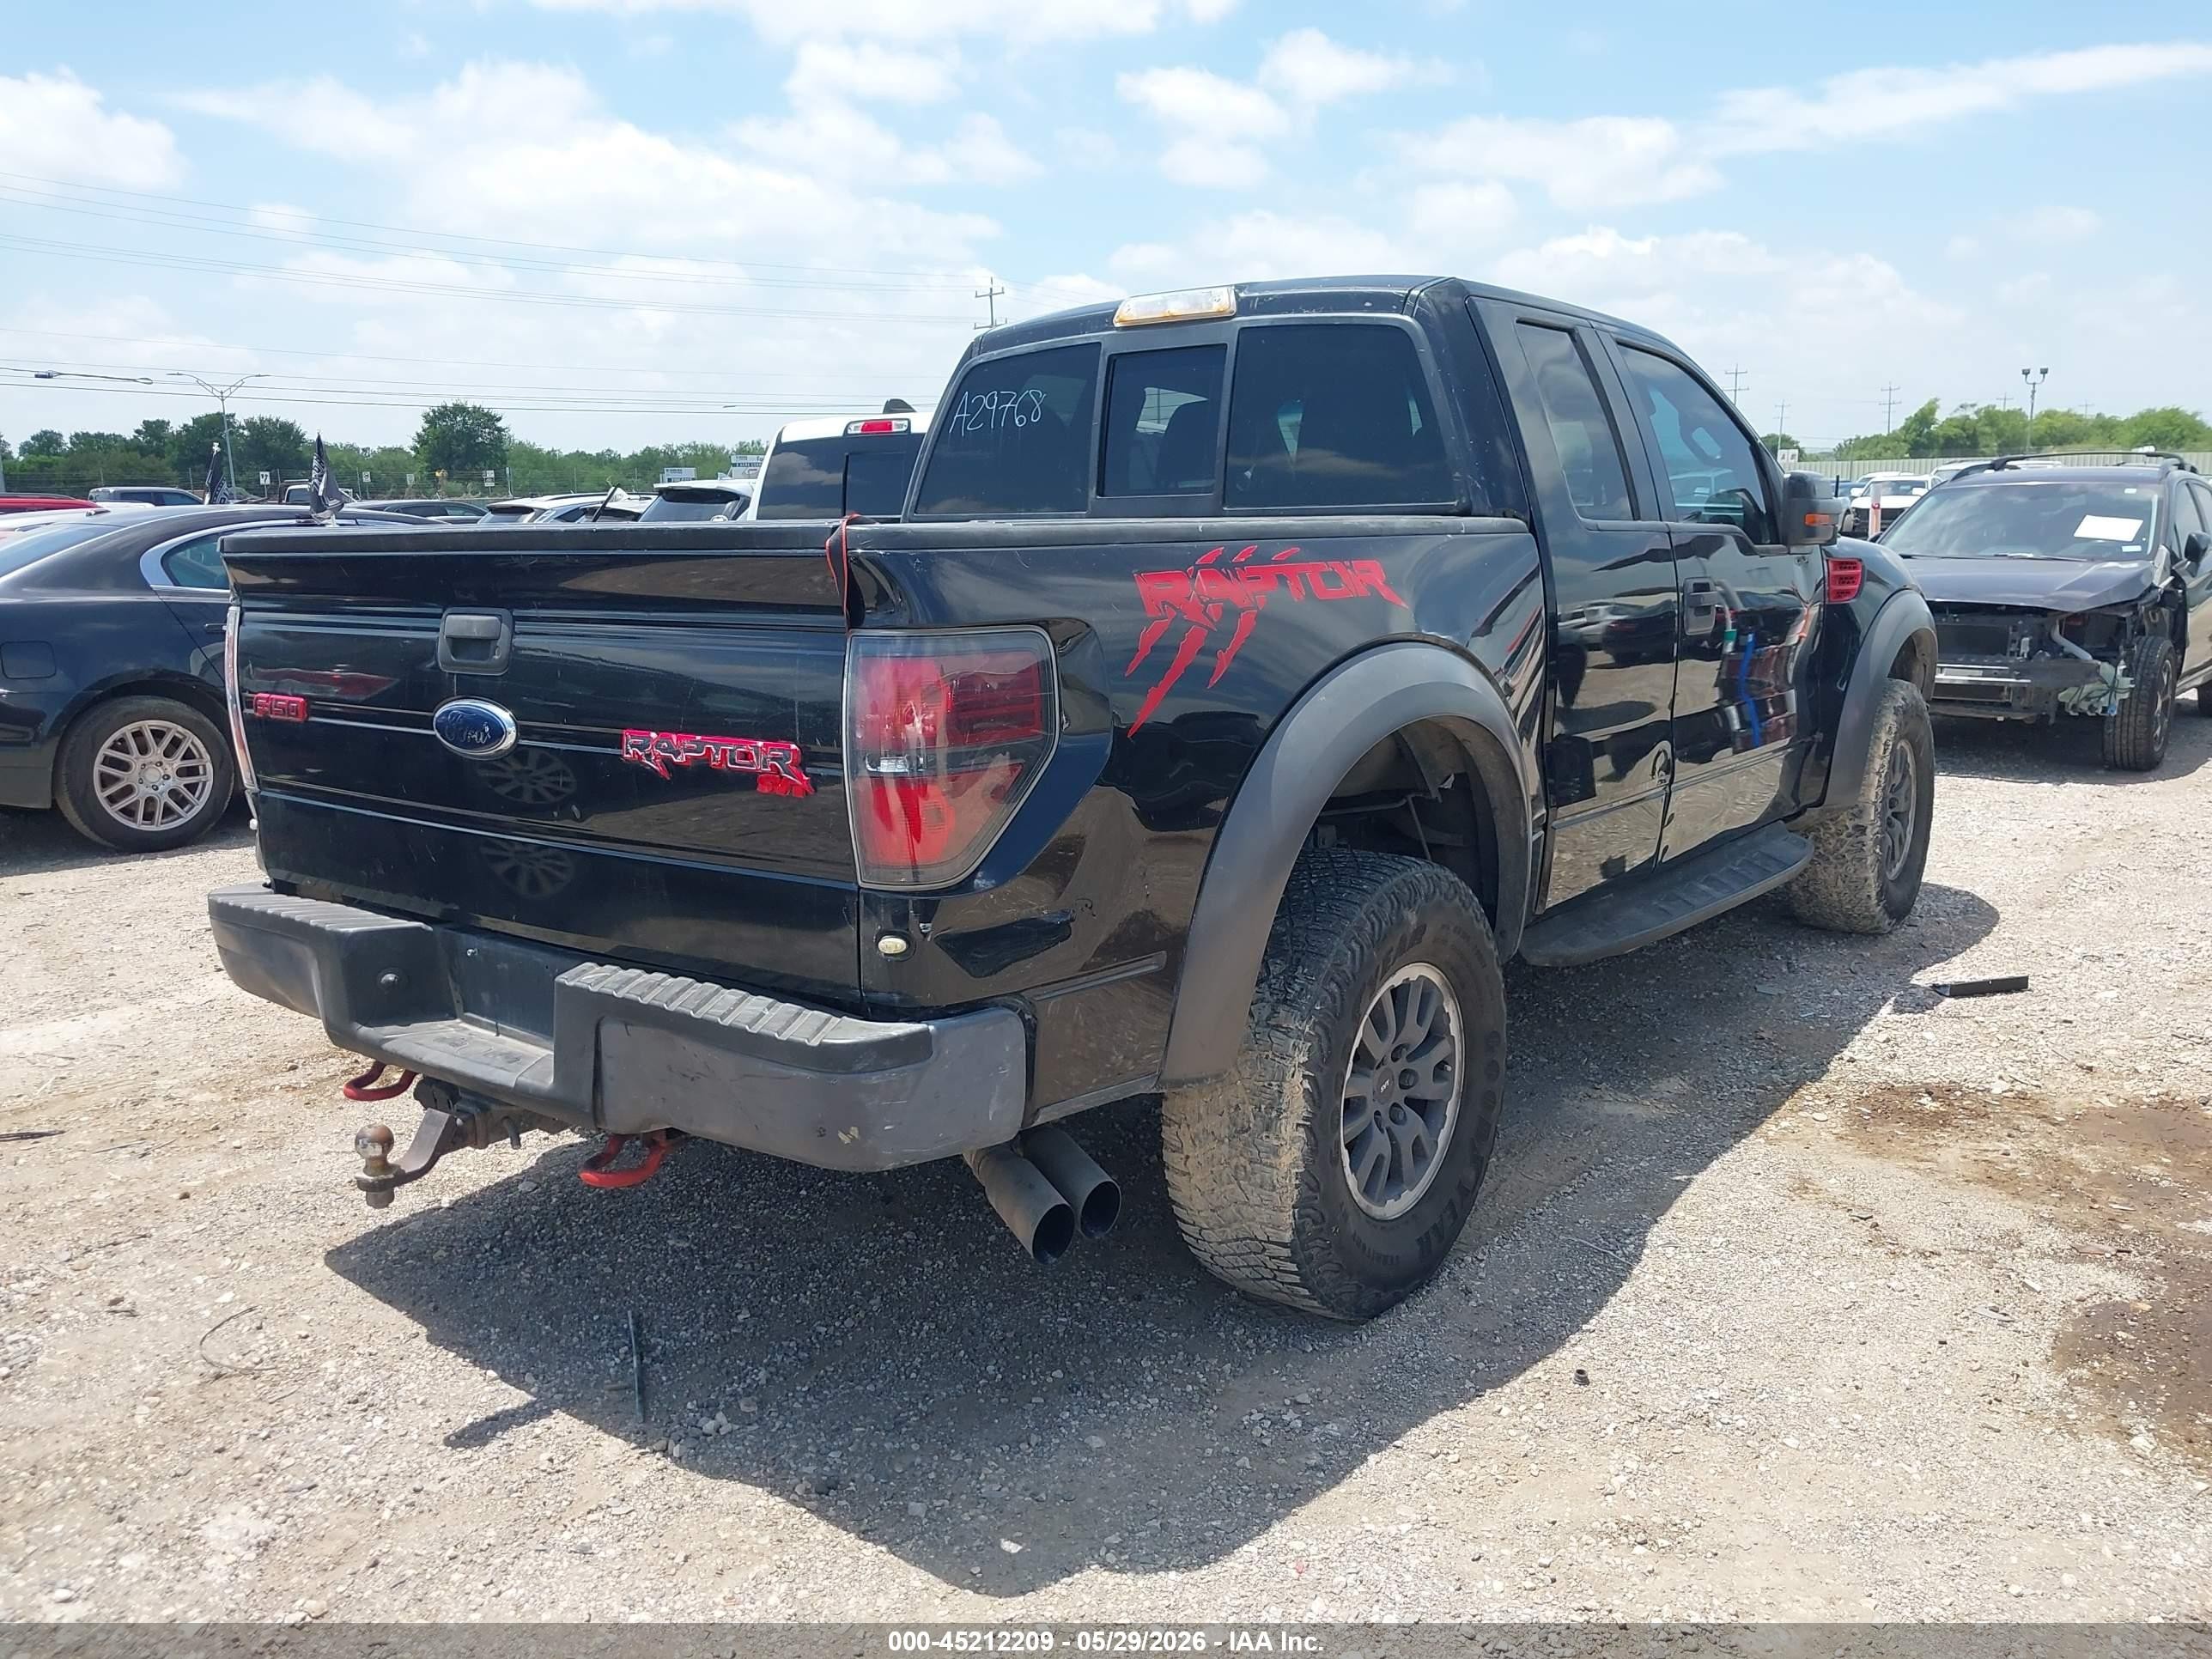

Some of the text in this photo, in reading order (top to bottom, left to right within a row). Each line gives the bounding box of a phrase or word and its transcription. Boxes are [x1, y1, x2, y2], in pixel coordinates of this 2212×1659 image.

[949, 389, 1047, 437] A29768
[623, 729, 815, 795] RAPTOR
[1380, 1079, 1389, 1093] SVT
